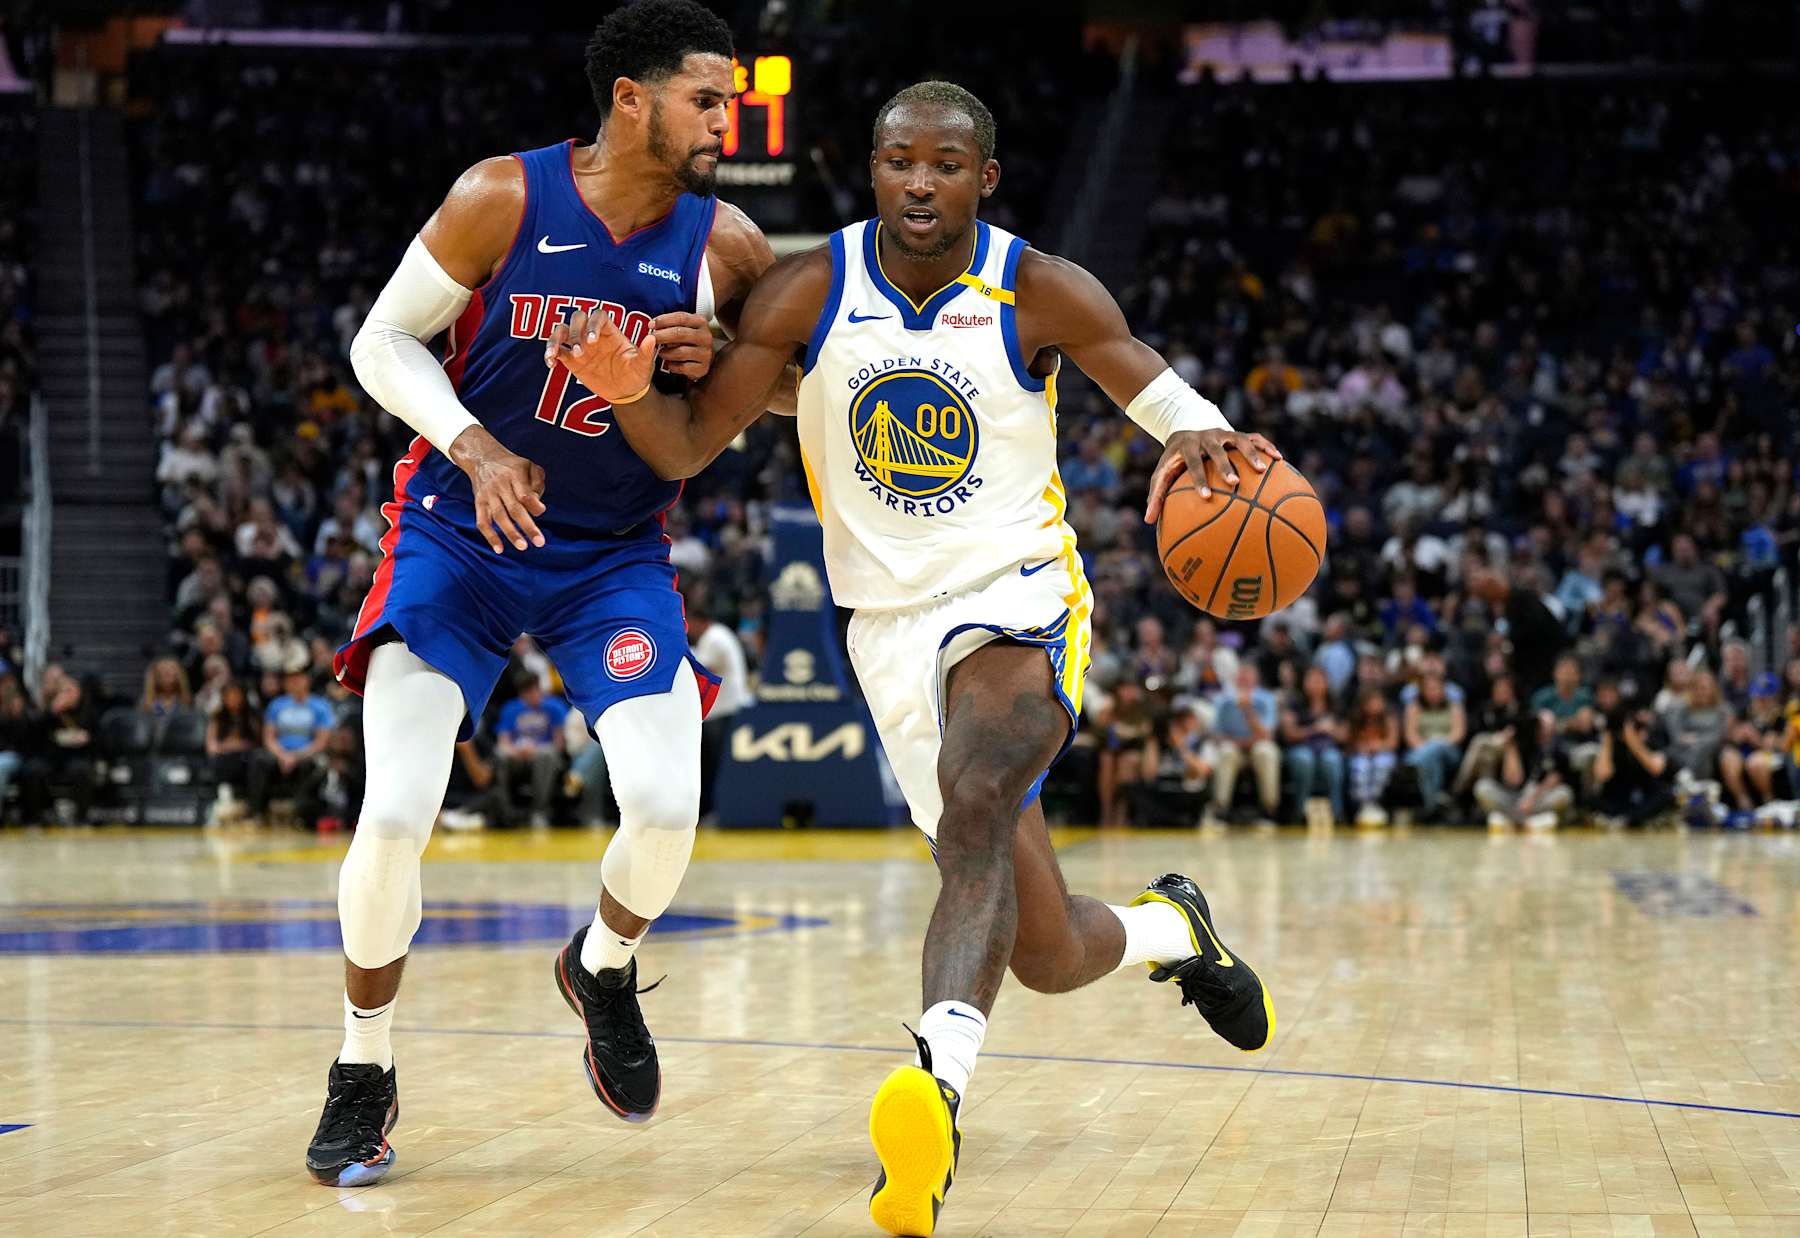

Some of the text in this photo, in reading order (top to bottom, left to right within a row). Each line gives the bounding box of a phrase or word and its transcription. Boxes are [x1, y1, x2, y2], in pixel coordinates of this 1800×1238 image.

[980, 284, 992, 296] 16
[942, 313, 993, 326] Rakuten
[848, 357, 980, 401] GOLDEN STATE
[916, 403, 961, 440] 00
[854, 459, 983, 518] WARRIORS
[612, 643, 644, 658] DETROIT
[613, 651, 646, 667] PISTONS
